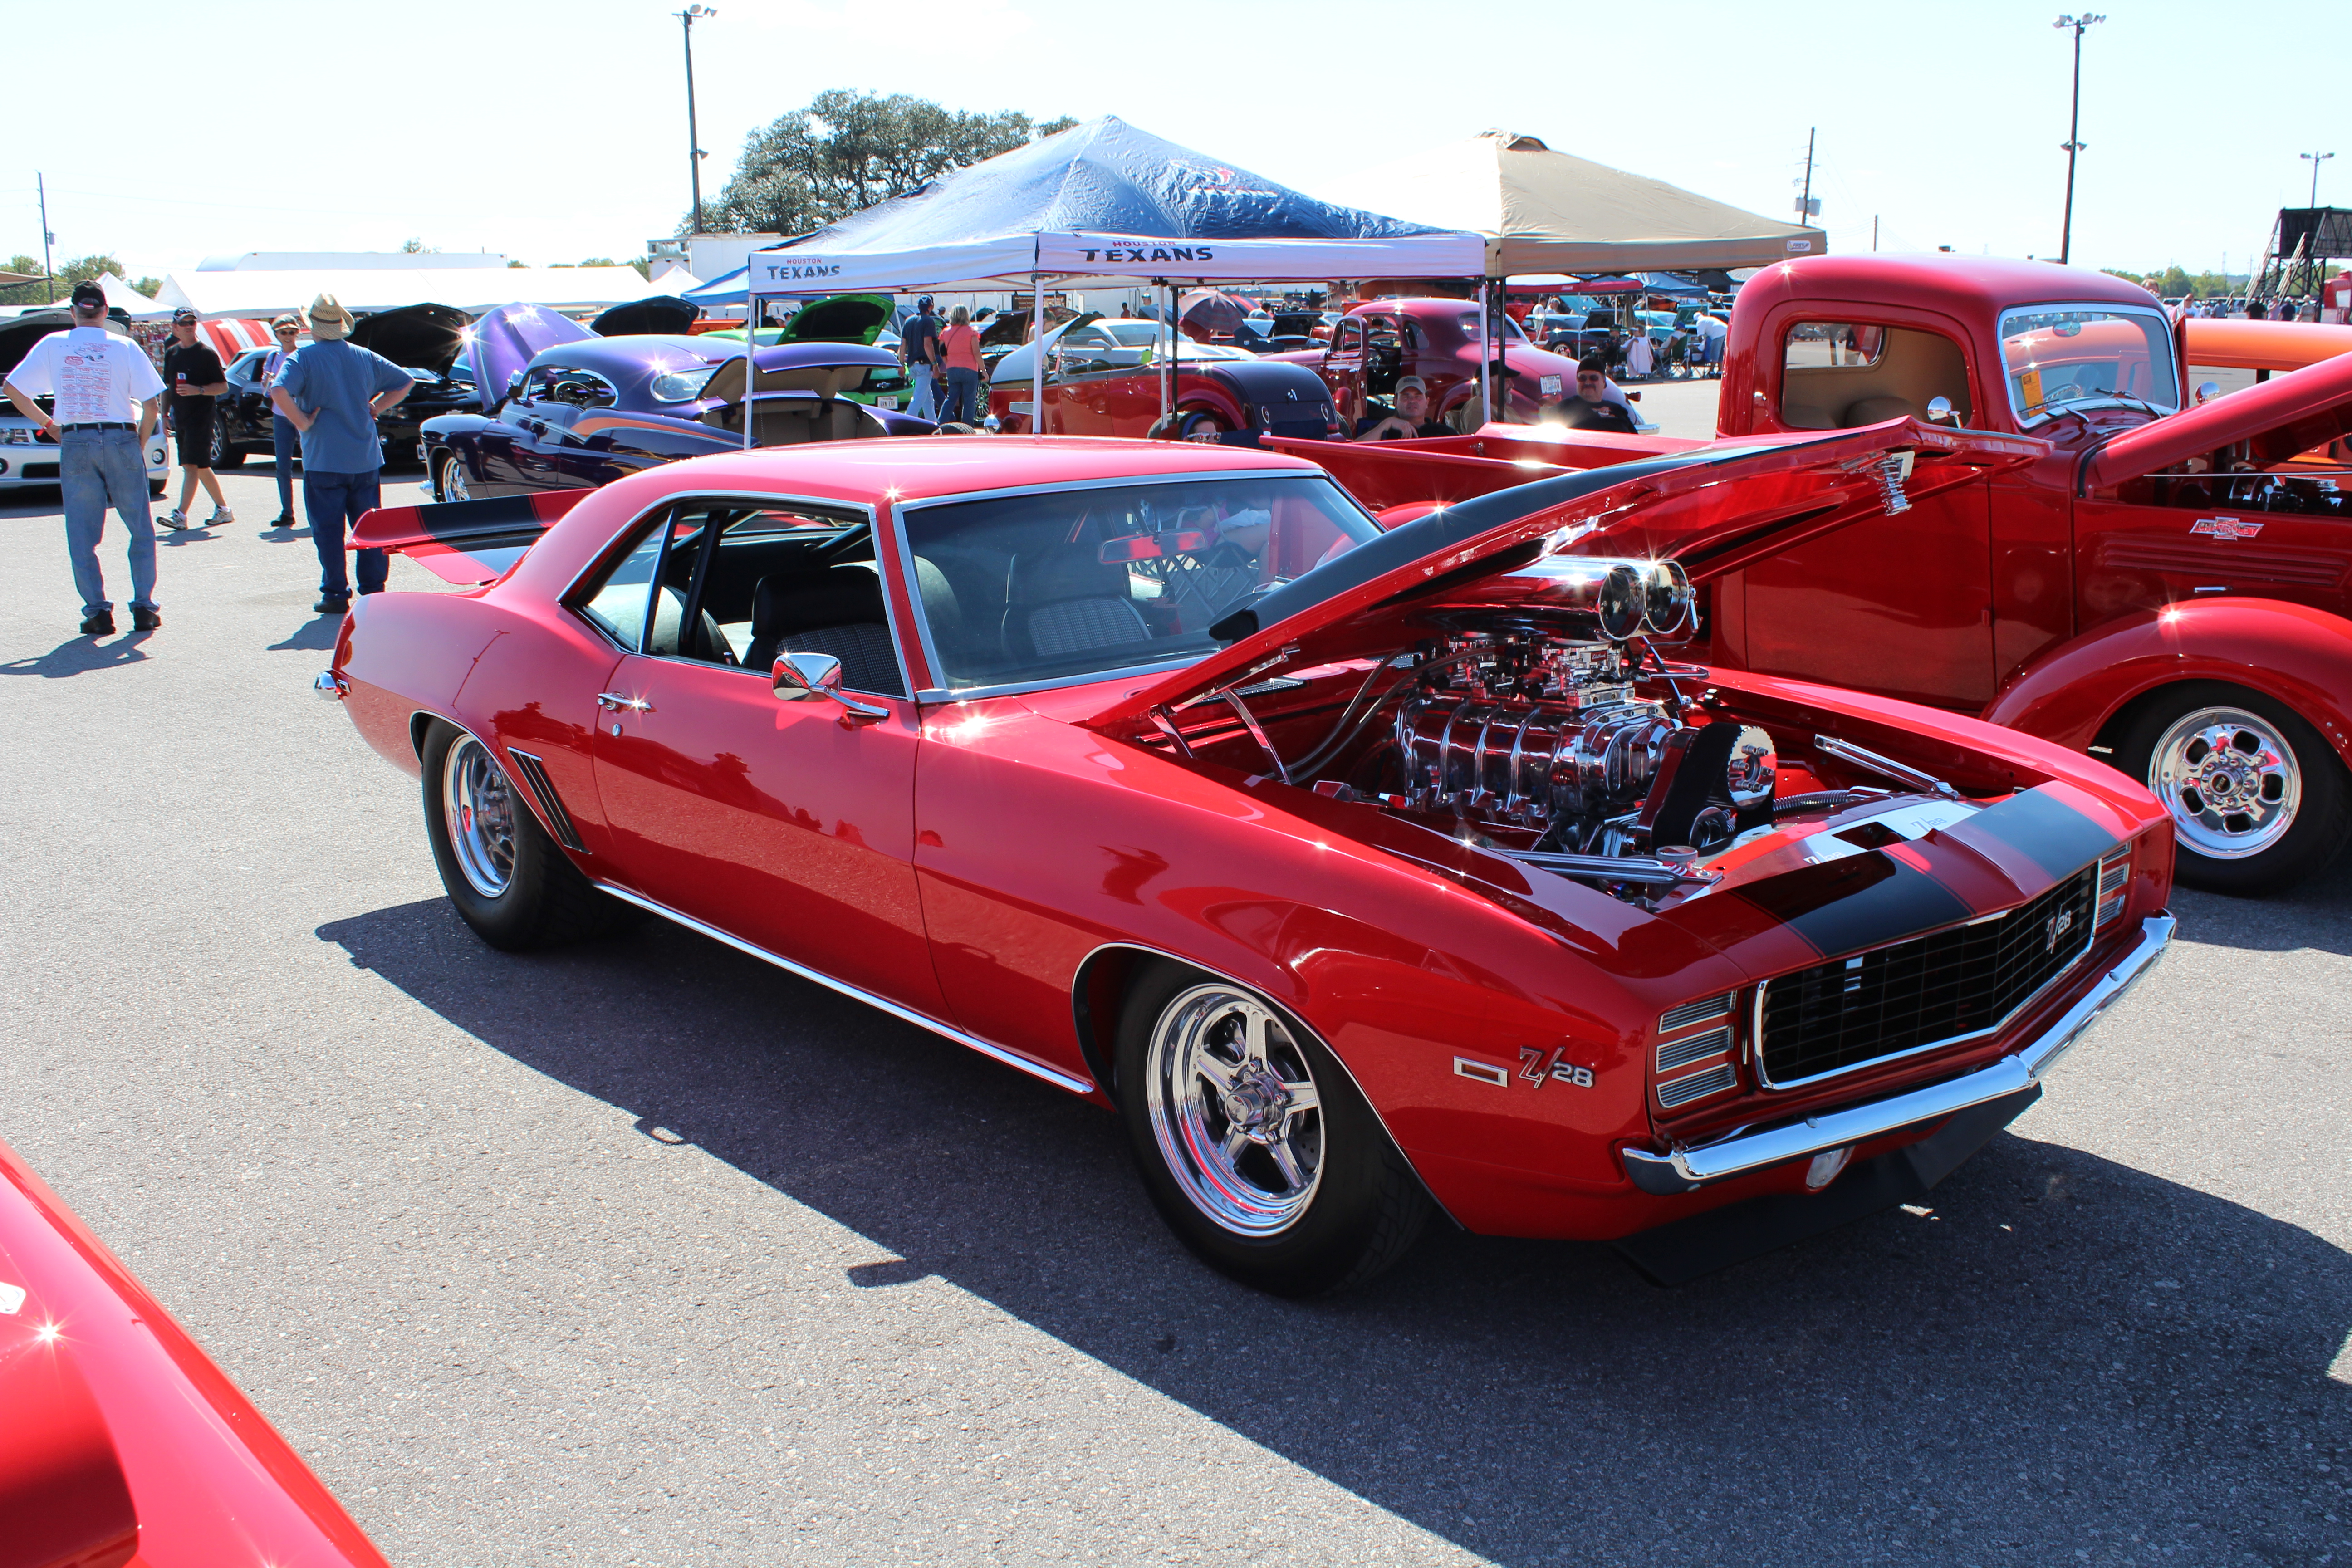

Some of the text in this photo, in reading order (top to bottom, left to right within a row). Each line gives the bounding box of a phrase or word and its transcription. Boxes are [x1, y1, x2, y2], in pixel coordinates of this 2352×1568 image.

[1076, 247, 1213, 262] TEXANS
[767, 265, 840, 279] TEXANS
[2198, 523, 2255, 535] CHEVROLET
[2046, 904, 2071, 954] Z/28
[1519, 1045, 1593, 1089] Z/28
